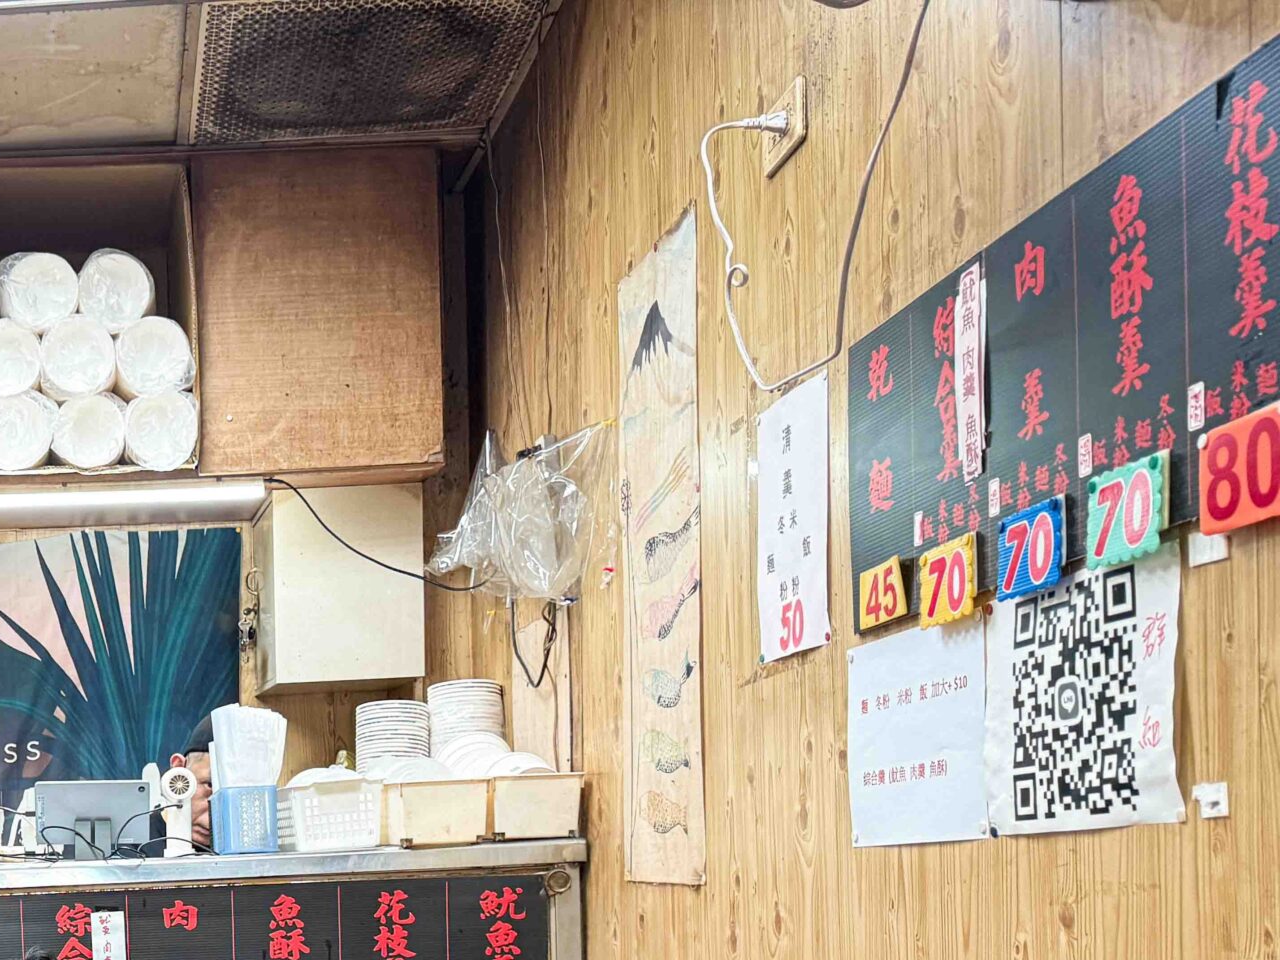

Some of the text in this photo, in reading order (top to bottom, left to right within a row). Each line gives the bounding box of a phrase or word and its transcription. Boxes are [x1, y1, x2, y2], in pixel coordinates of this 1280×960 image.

[1224, 80, 1278, 338] 花枝羹
[1110, 174, 1154, 396] 魚酥羹
[1014, 241, 1049, 441] 肉羹
[867, 344, 895, 513] 乾麵
[1206, 416, 1280, 523] 80
[1002, 513, 1055, 593] 70
[1093, 470, 1153, 559] 70
[779, 598, 805, 652] 50
[865, 564, 897, 623] 45
[926, 551, 967, 619] 70
